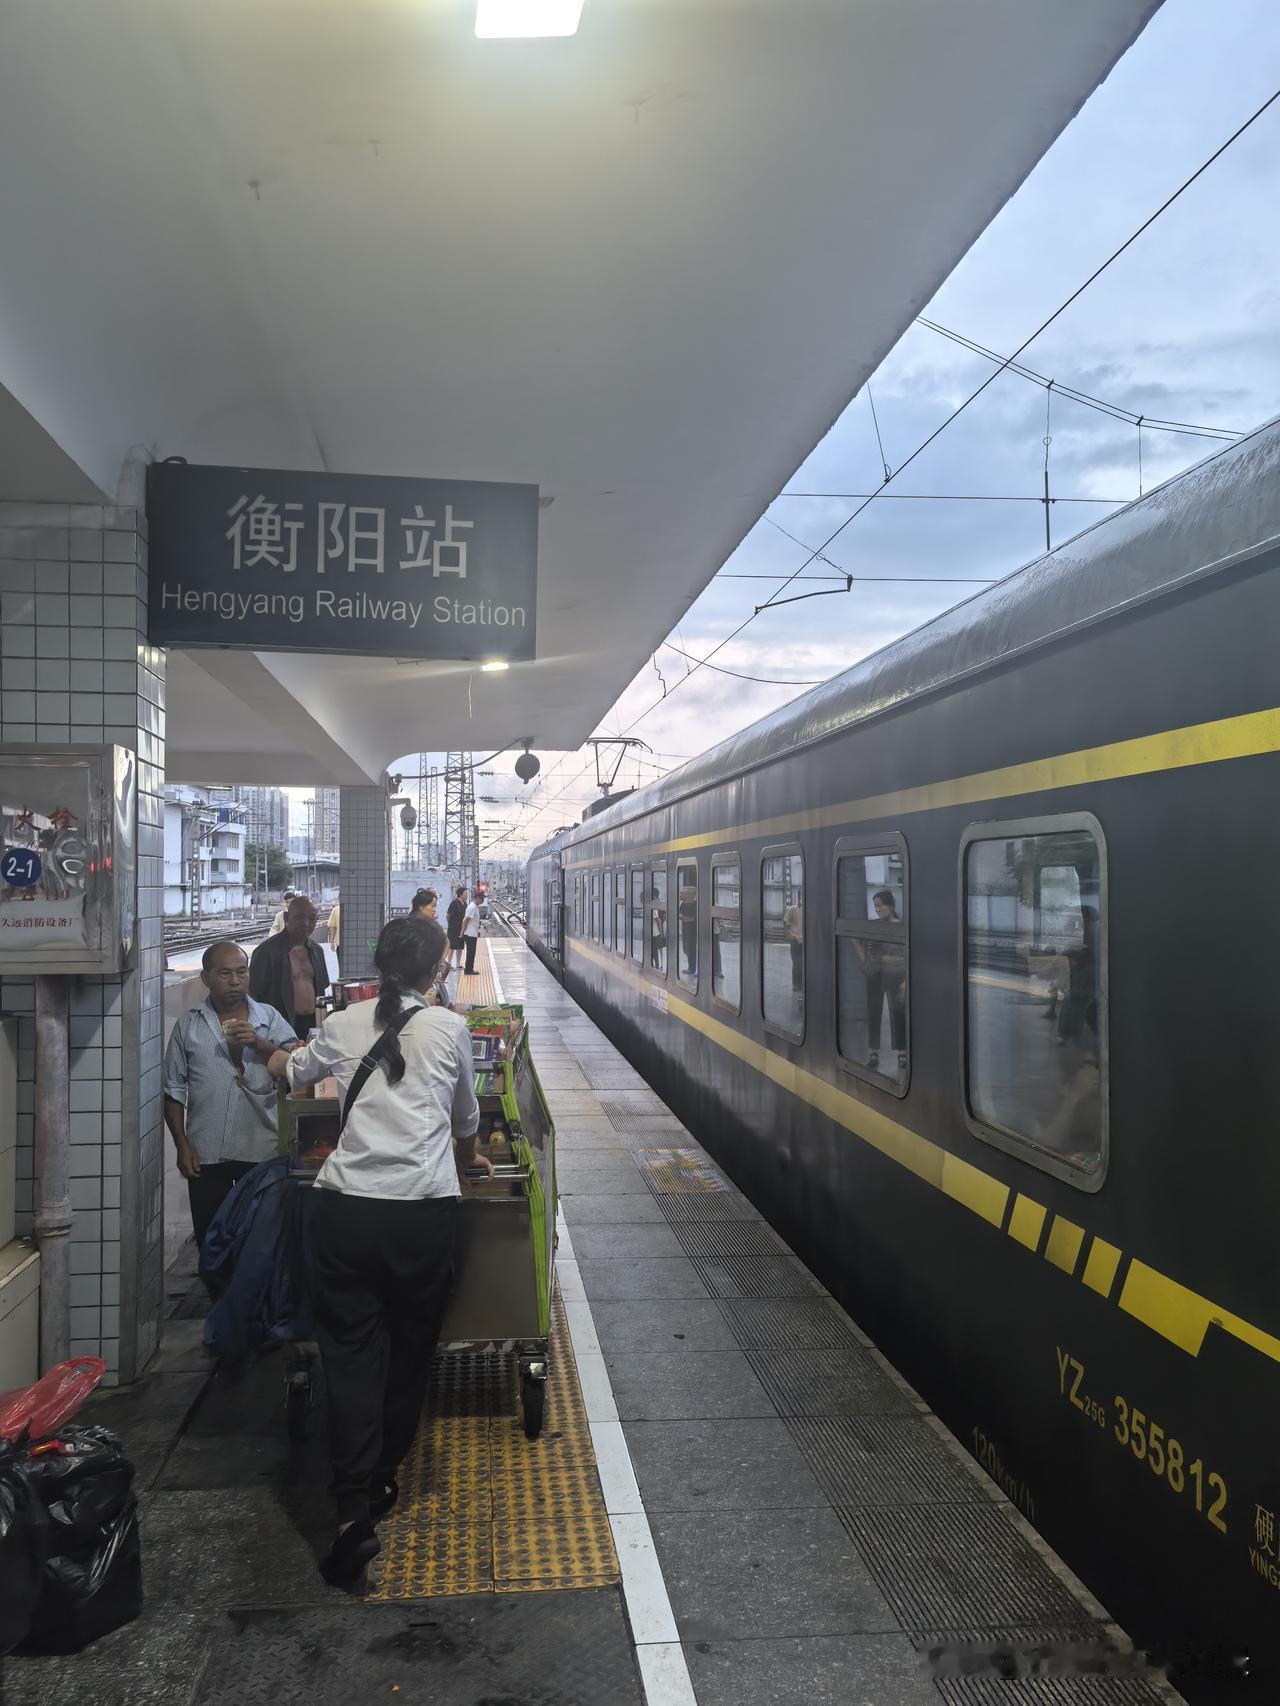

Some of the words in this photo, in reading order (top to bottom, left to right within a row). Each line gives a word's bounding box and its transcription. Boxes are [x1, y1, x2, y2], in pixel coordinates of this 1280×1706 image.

[225, 494, 475, 579] 衡阳站
[161, 582, 305, 623] Hengyang
[315, 590, 423, 628] Railway
[432, 596, 526, 628] Station
[6, 857, 34, 879] 2-1
[1113, 1395, 1228, 1535] 355812
[1254, 1503, 1280, 1562] 硬
[1248, 1545, 1280, 1591] YING
